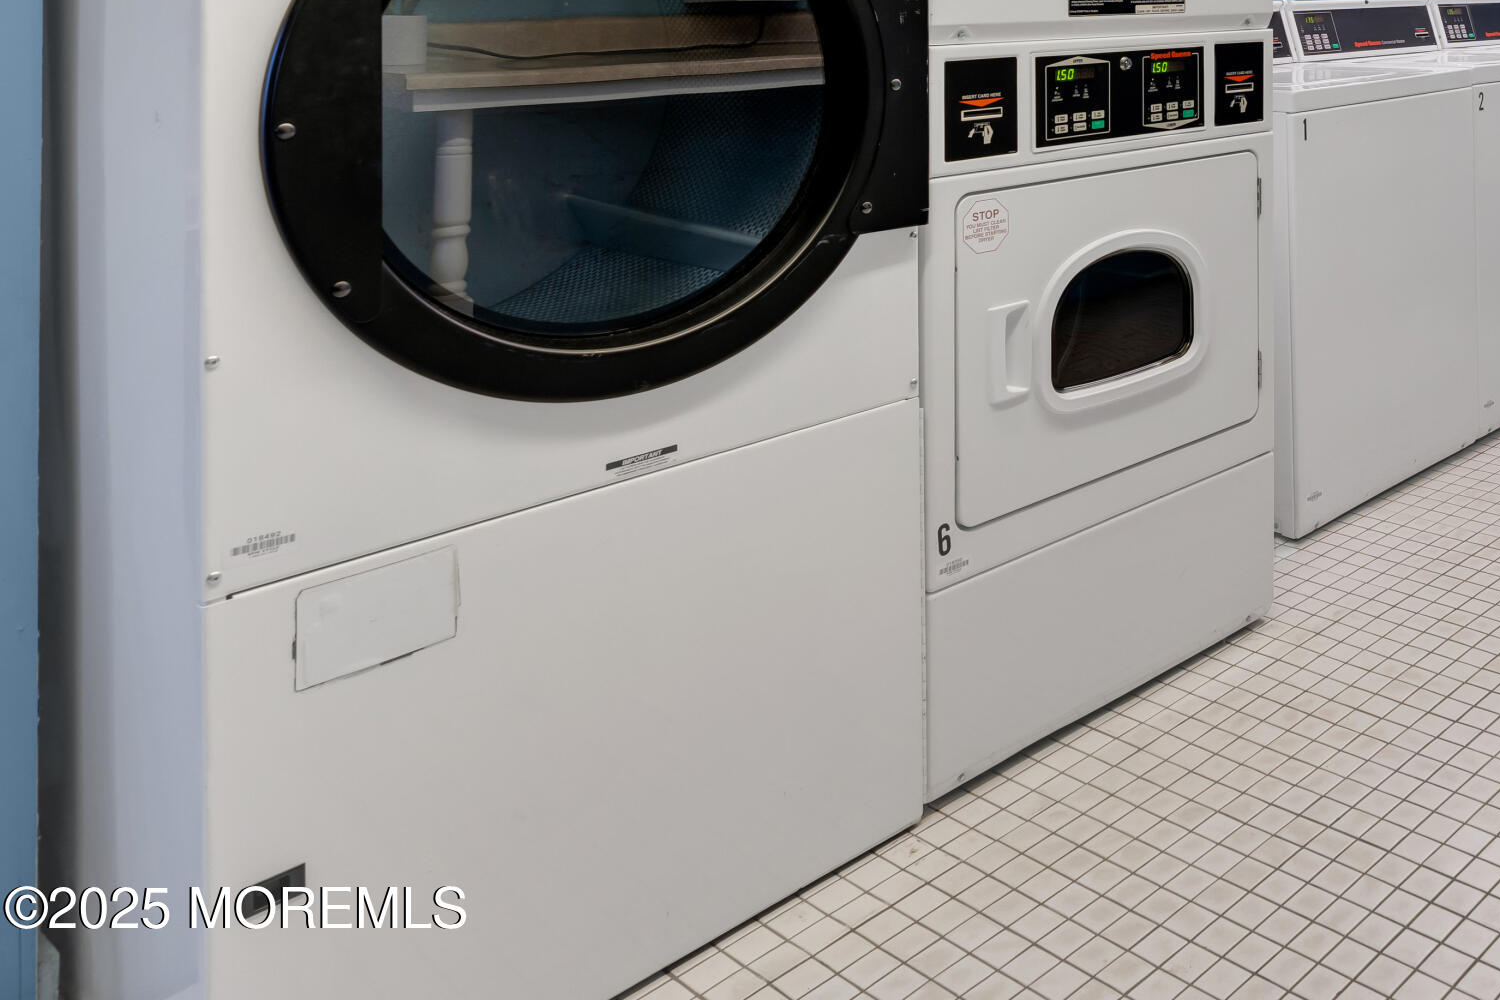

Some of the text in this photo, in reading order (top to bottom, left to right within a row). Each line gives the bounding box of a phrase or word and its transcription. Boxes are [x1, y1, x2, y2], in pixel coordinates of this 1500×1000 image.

[1150, 52, 1171, 61] Speed
[1478, 91, 1485, 111] 2
[1302, 117, 1308, 142] 1
[972, 209, 1000, 222] STOP
[621, 449, 663, 466] IMPORTANT
[937, 522, 952, 557] 6
